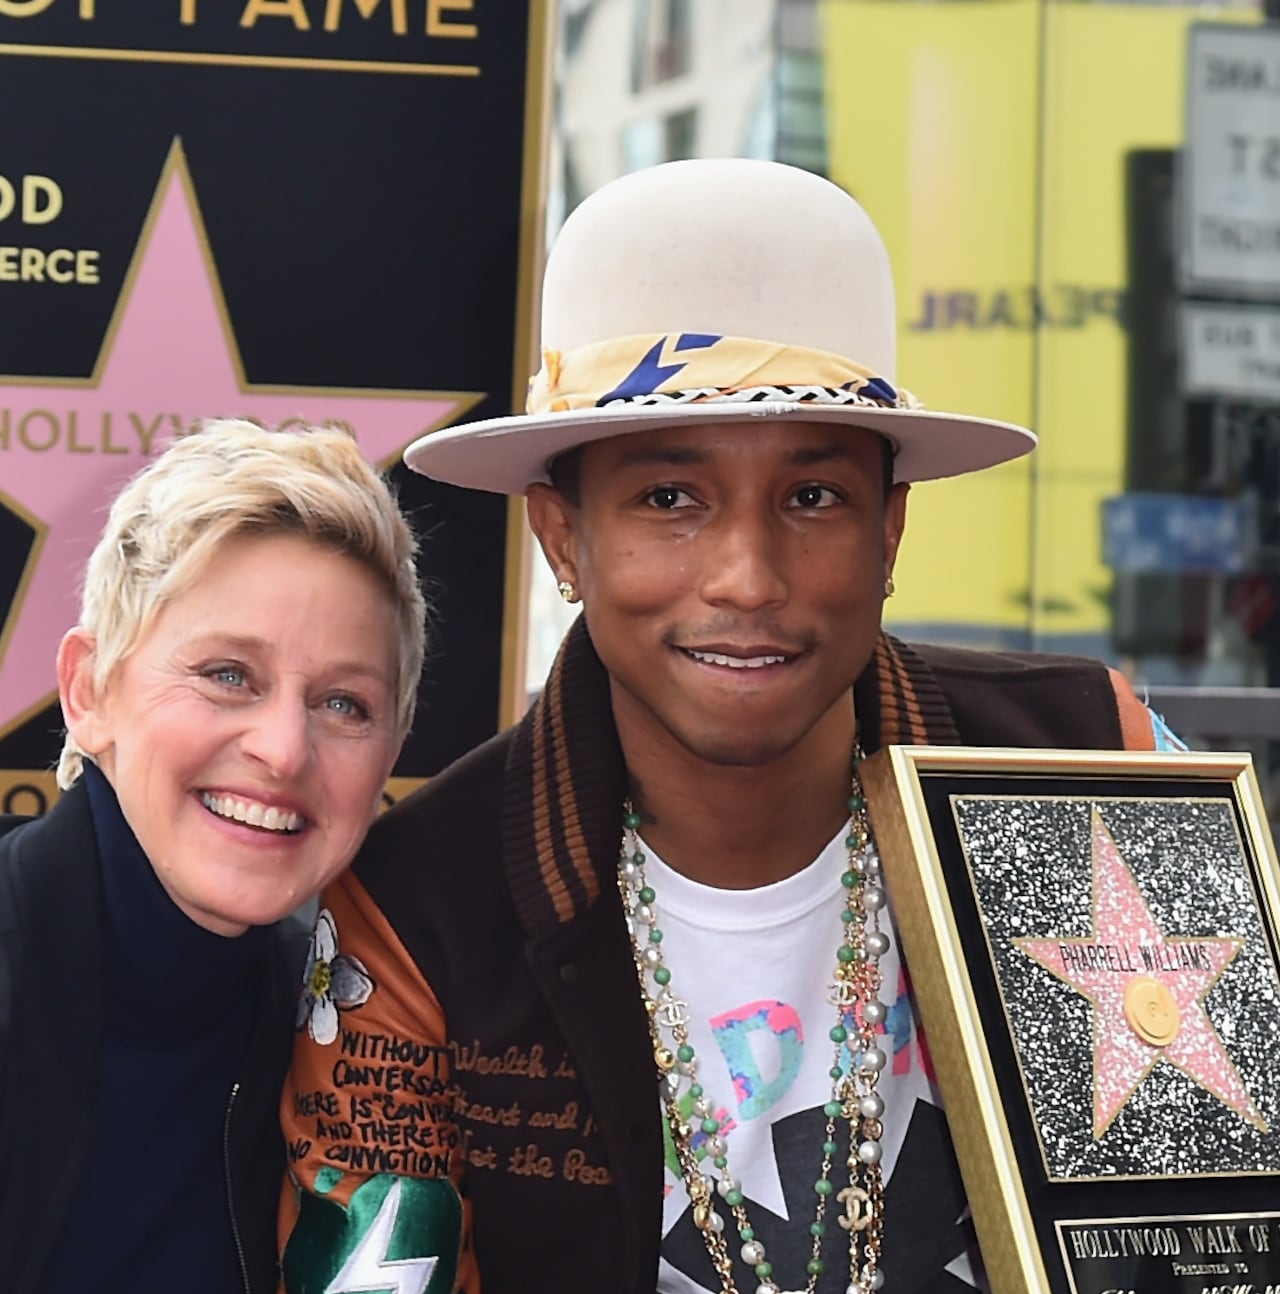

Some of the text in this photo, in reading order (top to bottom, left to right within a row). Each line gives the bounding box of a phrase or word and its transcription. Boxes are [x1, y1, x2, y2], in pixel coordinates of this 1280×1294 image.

[1059, 944, 1211, 972] PHARRELL WILLIAMS
[341, 1030, 451, 1078] WITHOUT
[333, 1059, 448, 1097] CONVERSA
[350, 1096, 372, 1123] IS
[528, 1100, 579, 1130] and
[317, 1118, 458, 1149] AND THEREFO
[324, 1145, 451, 1177] CONVICTION
[507, 1143, 555, 1178] the
[1070, 1227, 1180, 1259] HOLLYWOOD
[1186, 1225, 1243, 1255] WALK
[1248, 1224, 1270, 1253] OF
